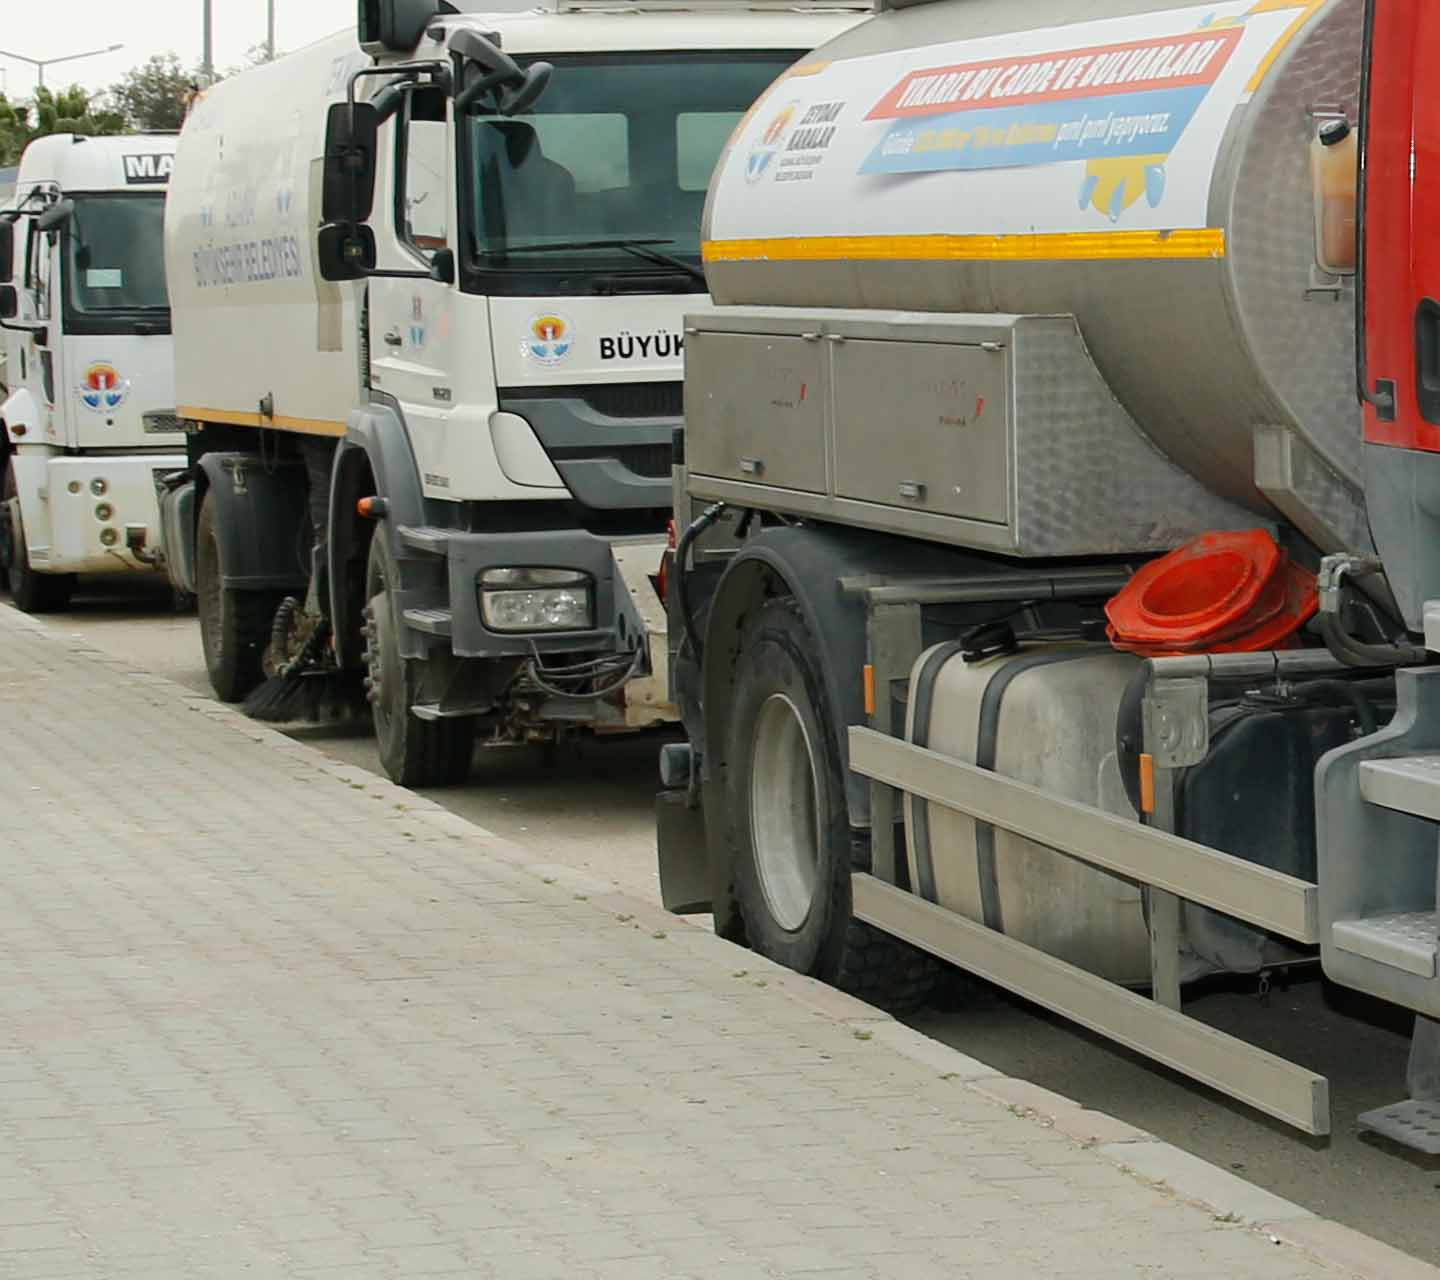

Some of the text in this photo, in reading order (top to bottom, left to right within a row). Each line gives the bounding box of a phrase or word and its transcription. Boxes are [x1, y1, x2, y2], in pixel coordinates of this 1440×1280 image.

[961, 67, 1002, 100] BU
[990, 60, 1062, 97] CADDE
[1053, 56, 1095, 91] VE
[1077, 37, 1228, 87] BULVARLARI
